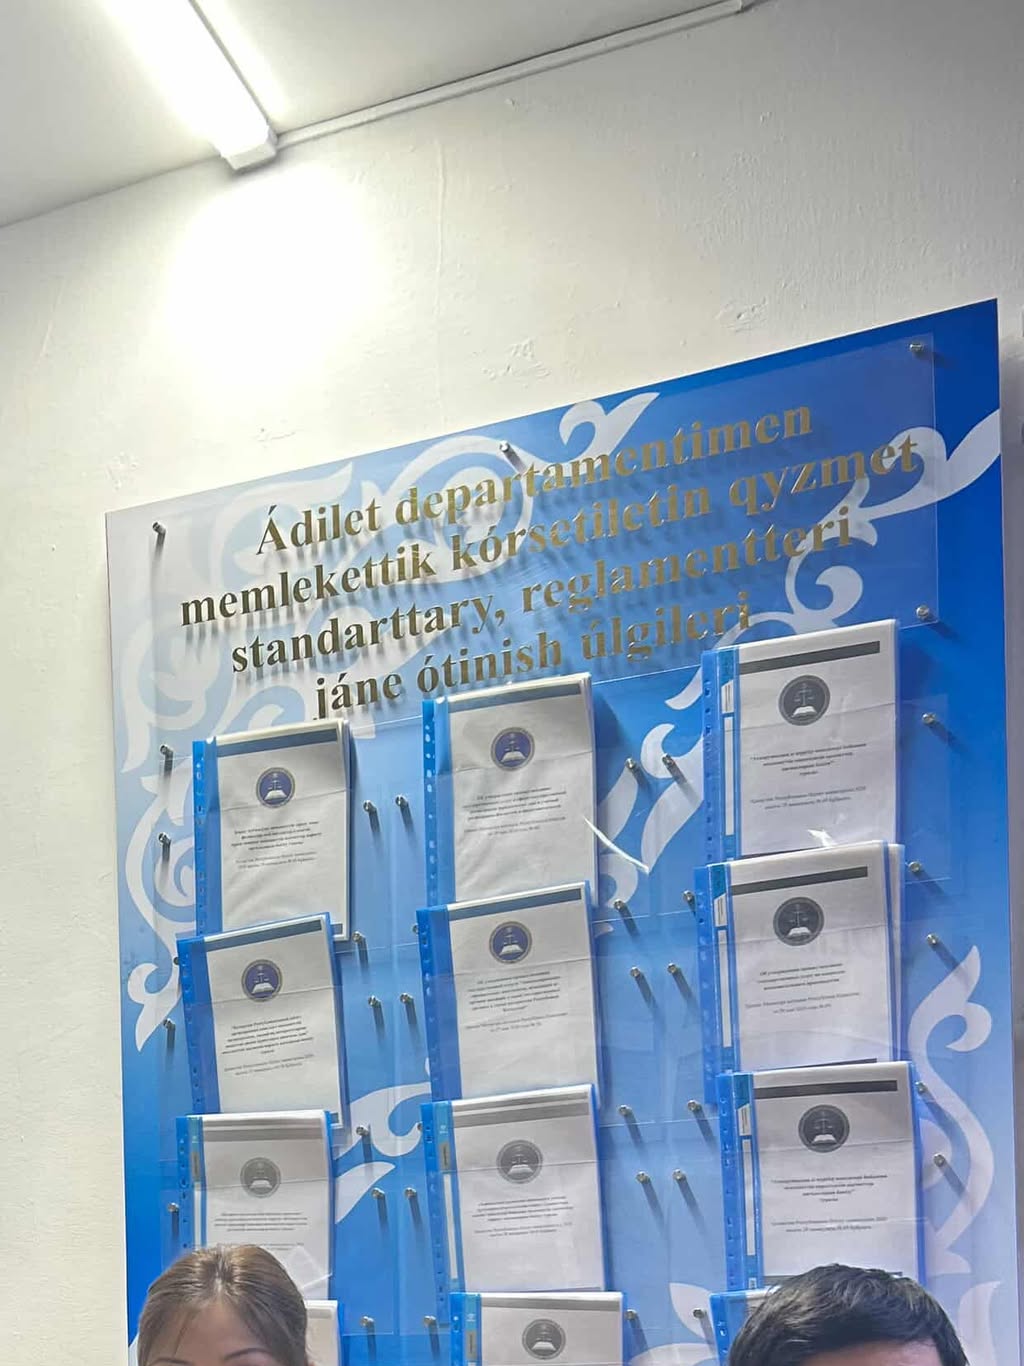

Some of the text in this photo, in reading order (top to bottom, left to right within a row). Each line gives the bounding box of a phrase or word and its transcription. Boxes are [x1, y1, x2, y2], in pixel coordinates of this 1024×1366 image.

[180, 434, 919, 627] memlekettik kórsetiletin qyzmet
[256, 405, 814, 555] Ádilet departamentimen
[231, 505, 852, 674] standarttary, reglamentteri
[312, 591, 750, 721] jáne ótinish úlgileri
